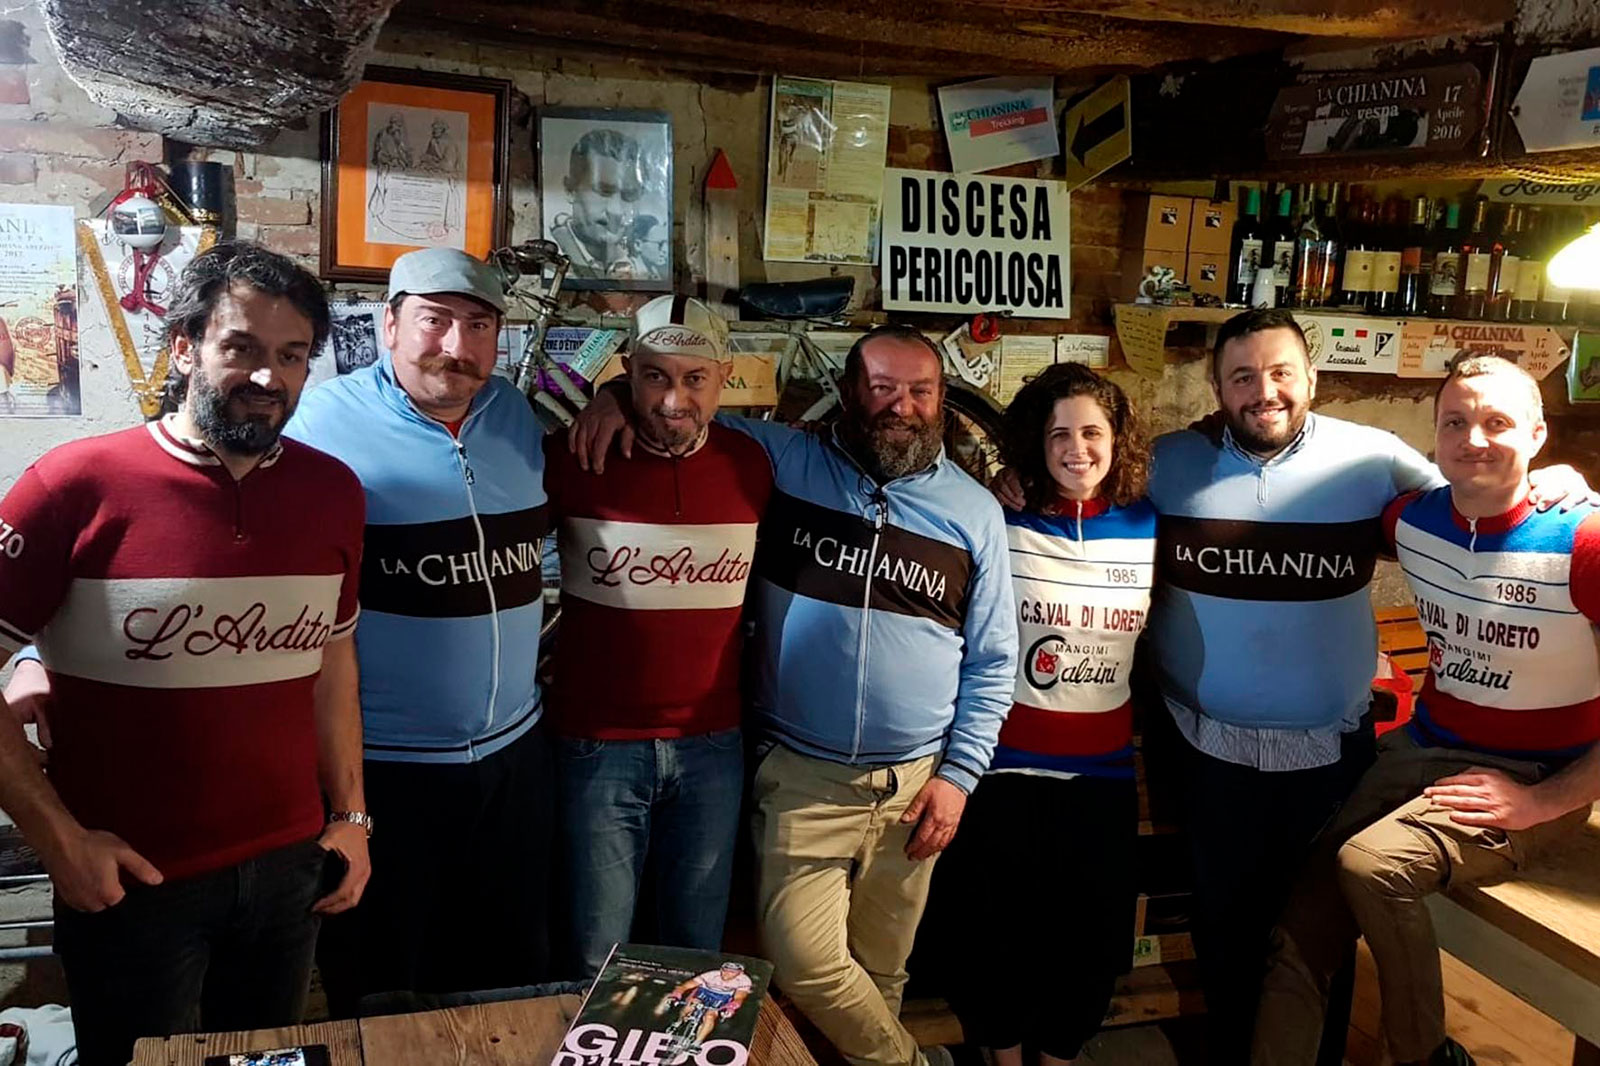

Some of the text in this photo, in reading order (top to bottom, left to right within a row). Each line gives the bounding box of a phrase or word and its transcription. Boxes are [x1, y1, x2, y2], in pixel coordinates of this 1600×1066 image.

[1337, 77, 1426, 105] CHIANINA
[1444, 85, 1462, 102] 17
[967, 100, 1028, 121] CHIANINA
[1357, 105, 1399, 124] vespa
[1432, 125, 1461, 140] 2016
[901, 177, 1052, 241] DISCESA
[889, 245, 1064, 309] PERICOLOSA
[1451, 326, 1525, 342] CHIANINA
[1535, 338, 1547, 349] 17
[1528, 363, 1548, 371] 2016
[380, 558, 411, 575] LA
[793, 528, 946, 602] LA CHIANINA
[1176, 545, 1355, 579] LA CHIANINA
[1105, 568, 1138, 584] 1985
[1496, 583, 1537, 605] 1985
[1081, 605, 1095, 629] DI
[1456, 612, 1468, 637] DI
[1478, 619, 1540, 650] LORETO
[1055, 643, 1109, 655] MANGIMI
[1024, 634, 1119, 690] Calzini
